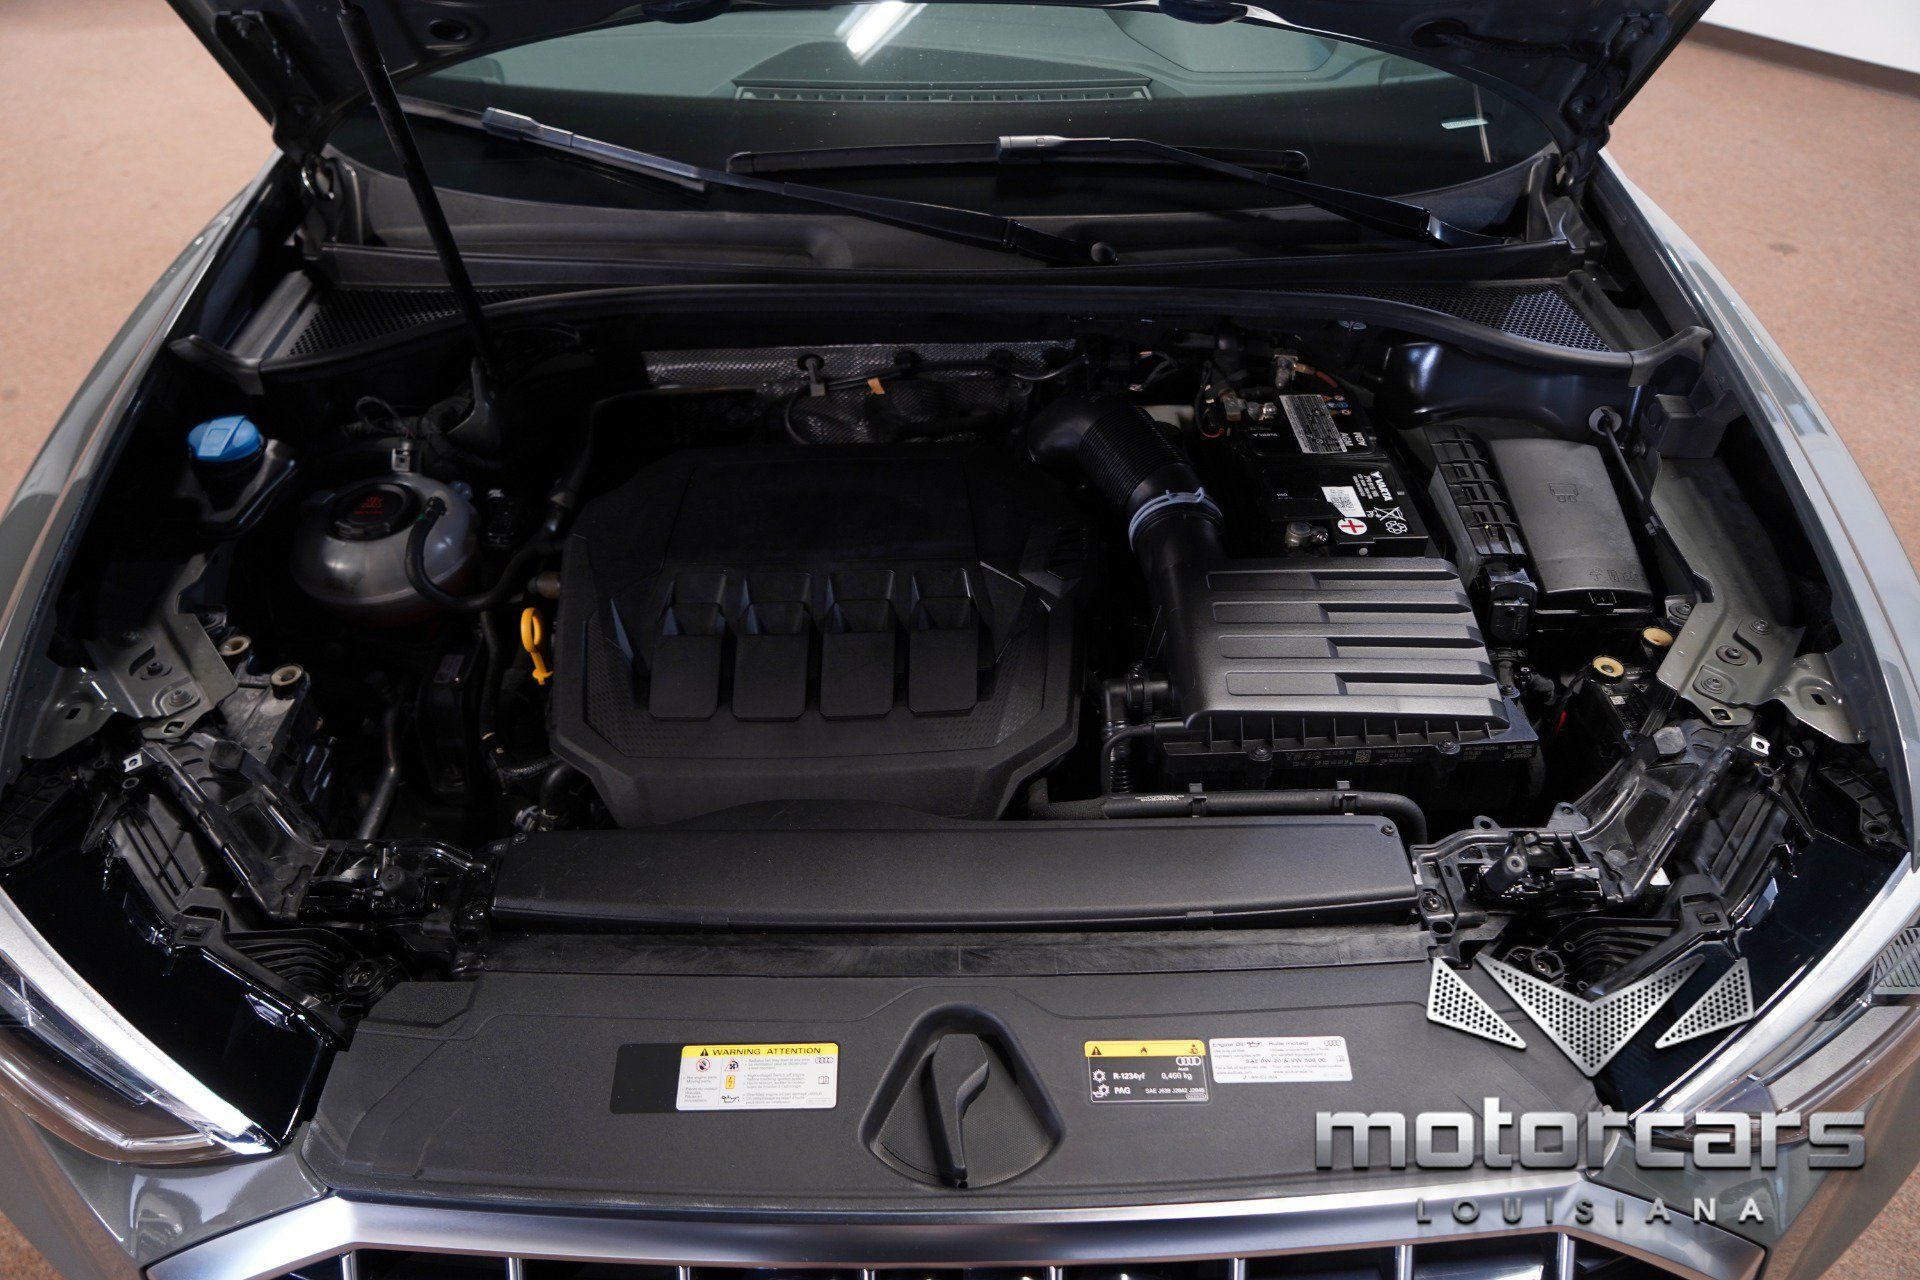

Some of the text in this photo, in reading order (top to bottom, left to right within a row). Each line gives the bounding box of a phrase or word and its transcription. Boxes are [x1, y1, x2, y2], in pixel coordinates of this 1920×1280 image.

[1375, 478, 1393, 502] VARTA
[713, 1047, 821, 1056] WARNING ATTENTION
[1113, 1072, 1193, 1081] R-1234yf 0,460 kg
[1114, 1086, 1132, 1095] PAG
